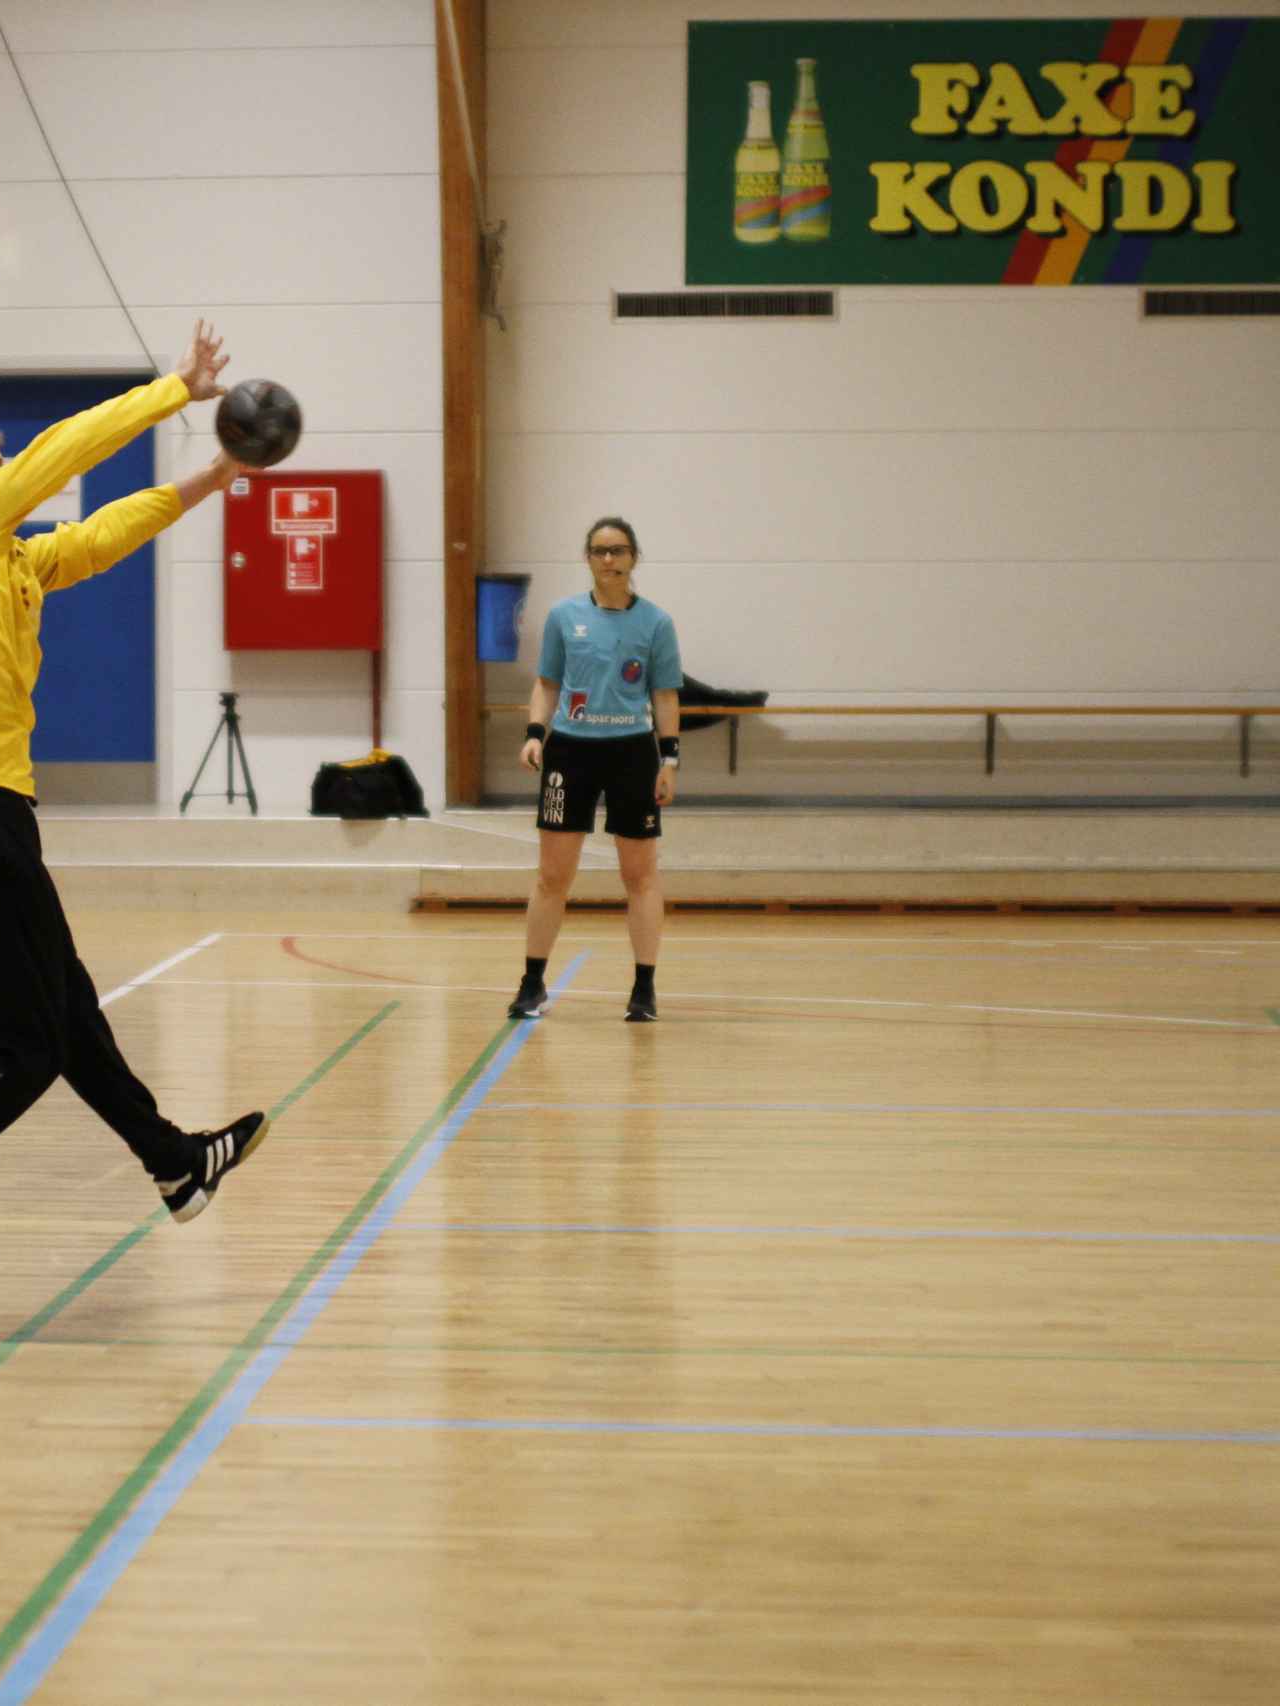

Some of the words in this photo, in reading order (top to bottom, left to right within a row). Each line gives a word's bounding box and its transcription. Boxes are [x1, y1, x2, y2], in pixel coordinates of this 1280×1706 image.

[910, 62, 1196, 138] FAXE
[869, 160, 1237, 235] KONDI
[544, 810, 564, 824] VIN
